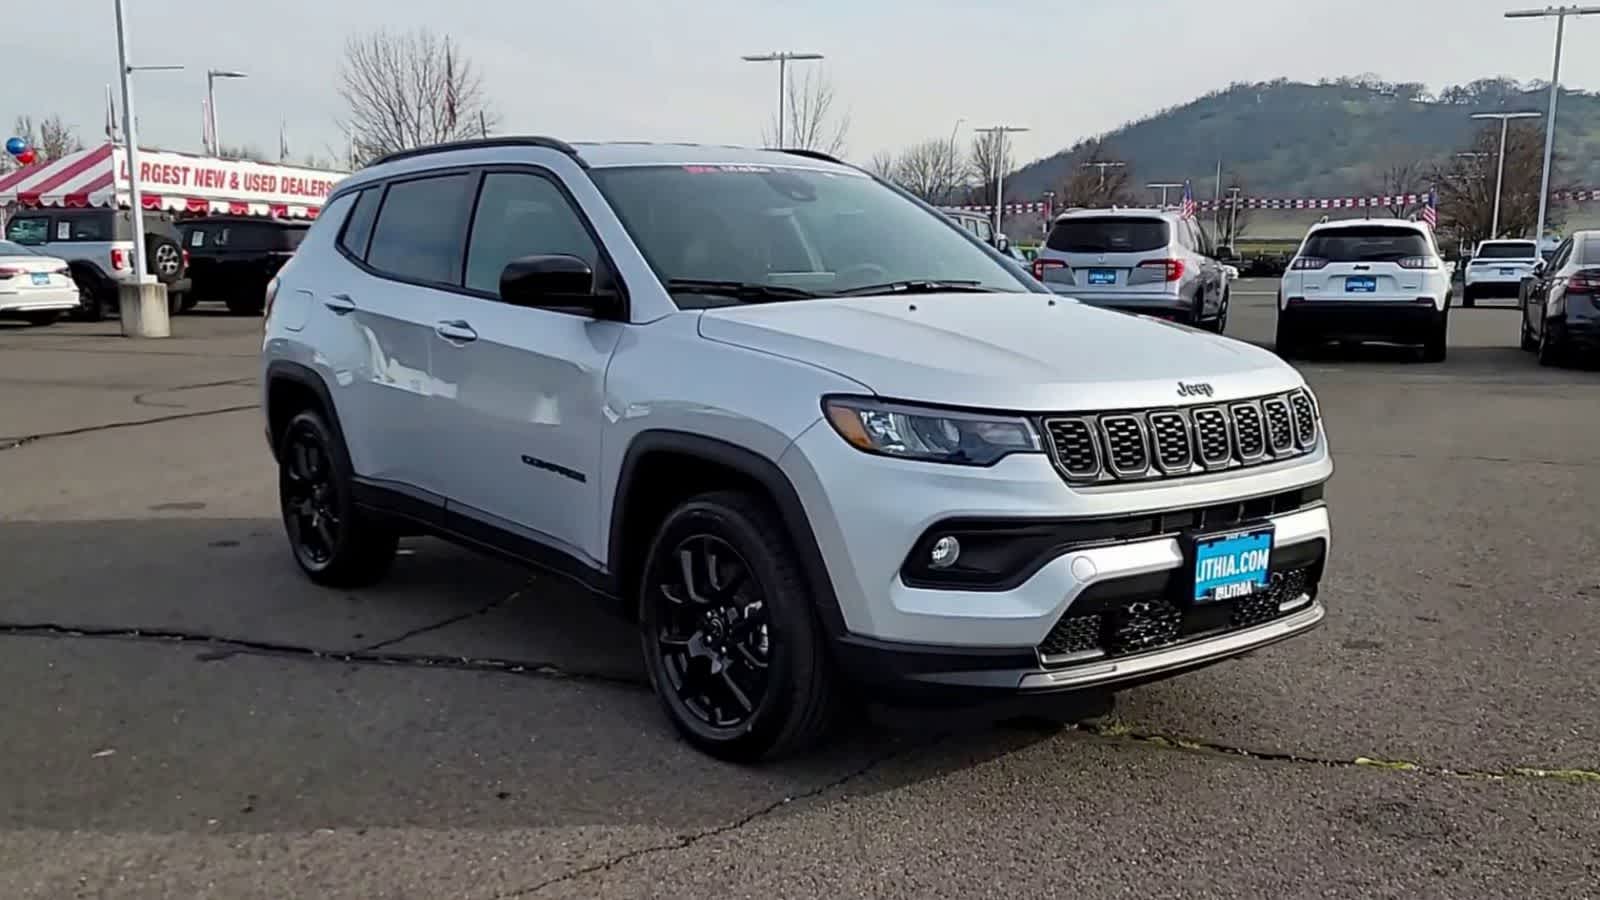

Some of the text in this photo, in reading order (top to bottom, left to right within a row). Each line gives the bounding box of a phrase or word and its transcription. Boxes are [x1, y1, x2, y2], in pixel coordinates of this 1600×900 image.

[120, 160, 337, 197] LRGEST NEW & USED DEALERS
[1176, 381, 1214, 398] Jeep
[1195, 548, 1270, 583] LITHIA.COM
